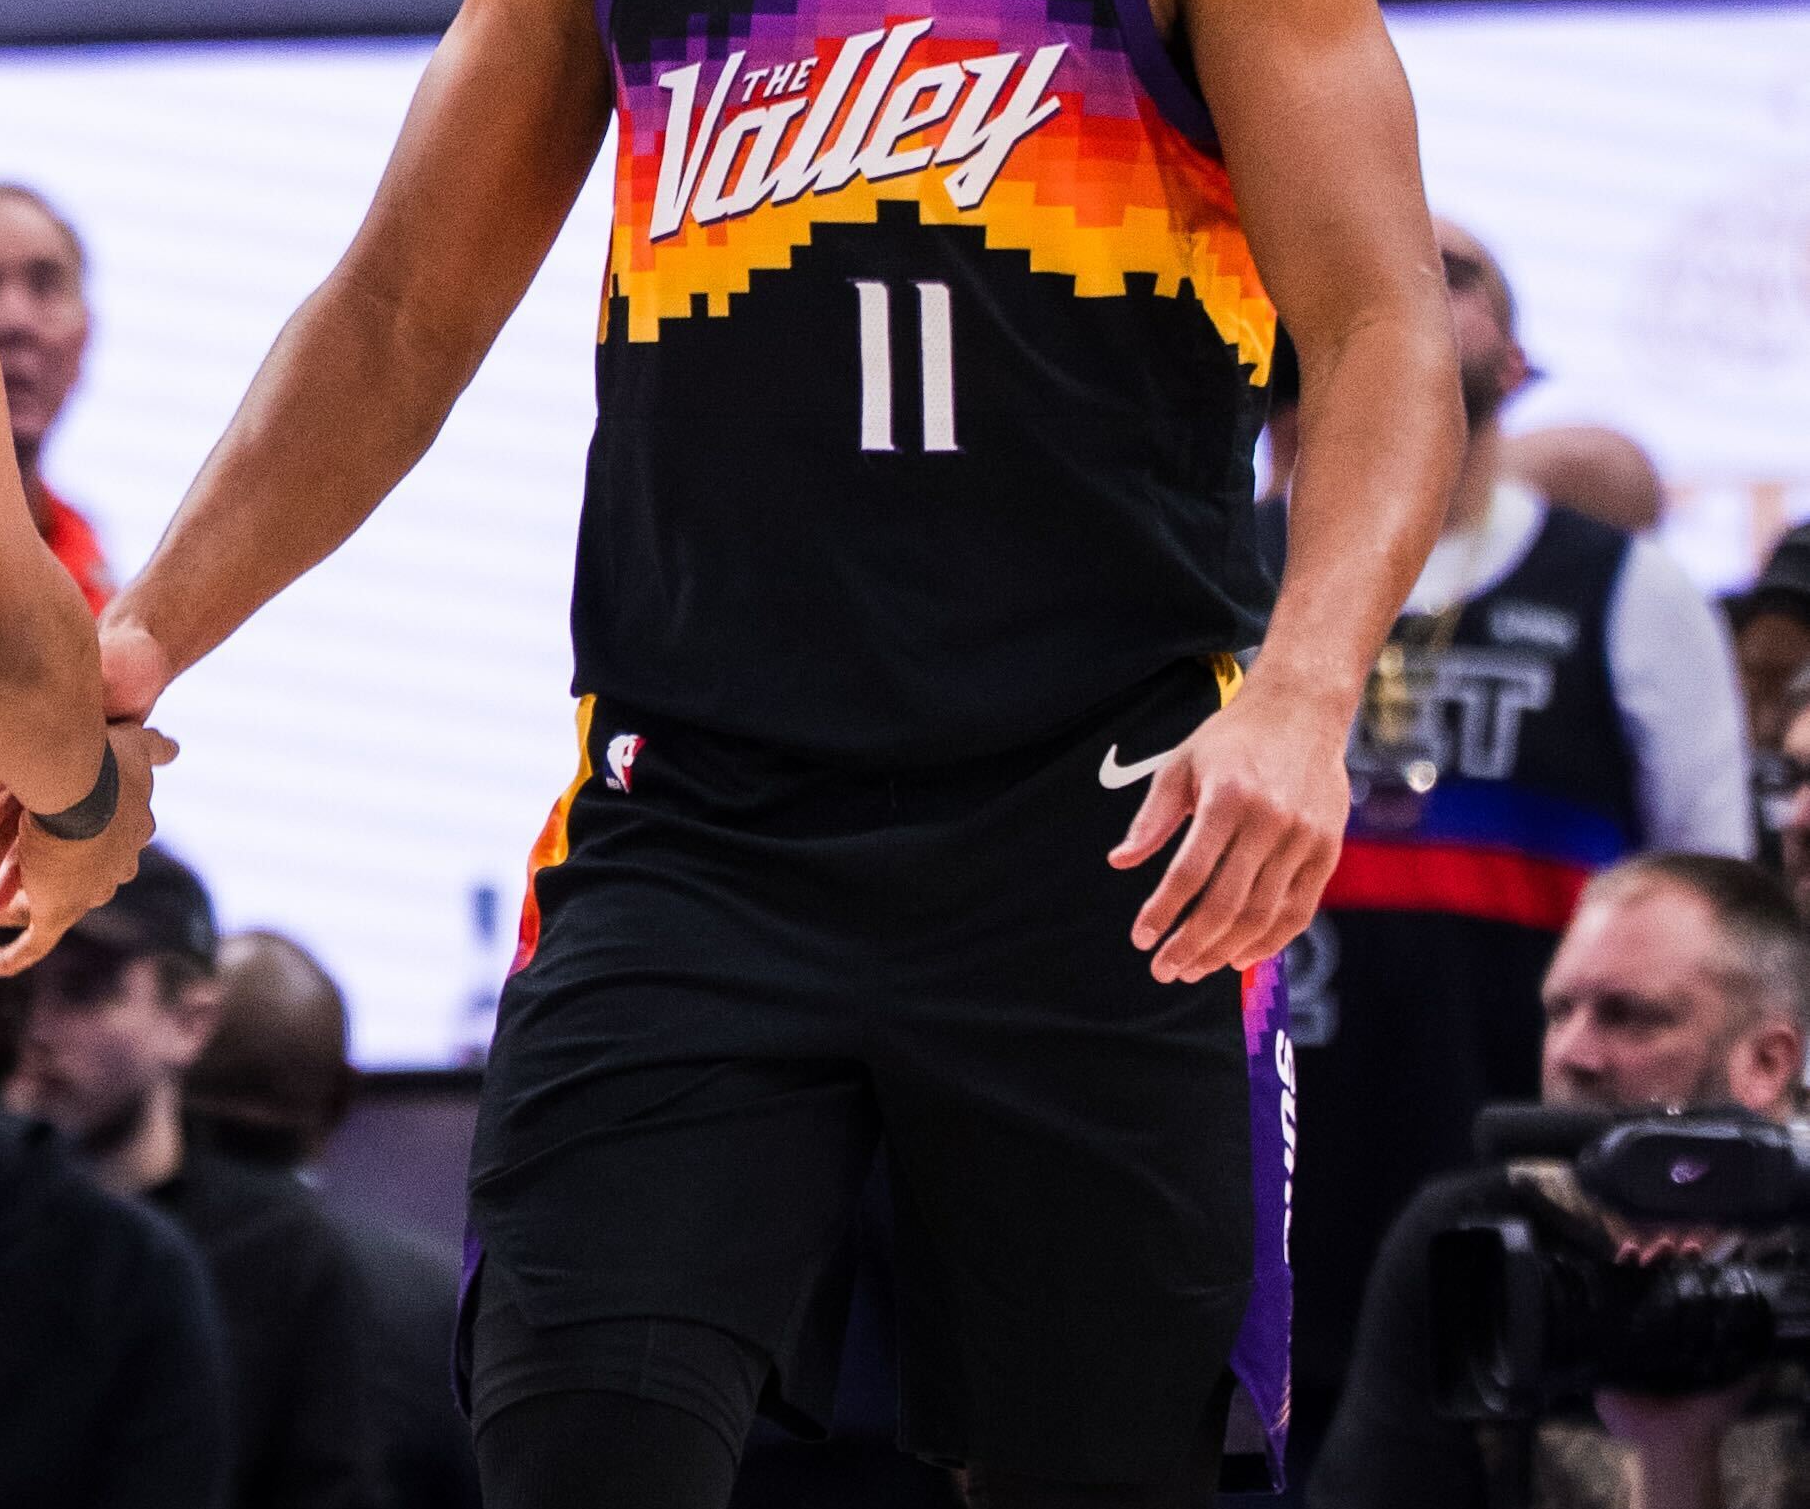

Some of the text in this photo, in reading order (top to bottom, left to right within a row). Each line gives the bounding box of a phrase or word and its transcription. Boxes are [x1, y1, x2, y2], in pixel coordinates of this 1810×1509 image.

[649, 17, 1070, 244] Valley
[741, 57, 819, 103] THE
[852, 278, 961, 454] 11
